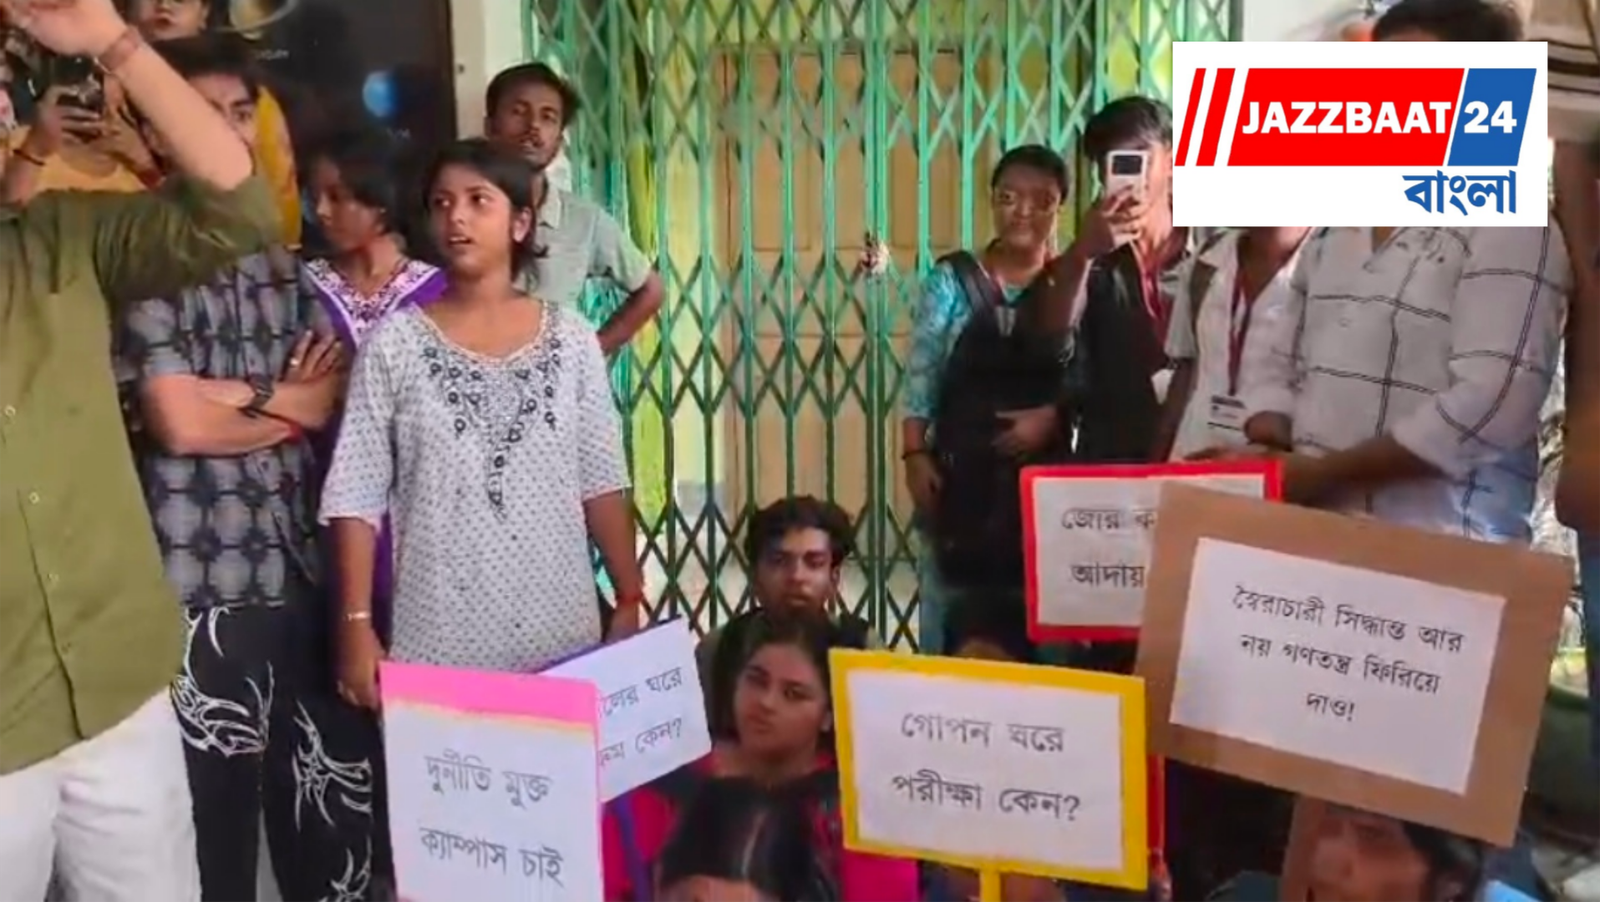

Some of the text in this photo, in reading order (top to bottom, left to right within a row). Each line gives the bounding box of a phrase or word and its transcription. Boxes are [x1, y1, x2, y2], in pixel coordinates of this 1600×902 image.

[1061, 507, 1120, 530] জোর
[1070, 561, 1145, 588] আদায়
[1334, 603, 1407, 640] সিদ্ধান্ত
[1418, 626, 1465, 653] আর
[645, 667, 683, 692] ঘরে
[1240, 634, 1441, 694] নয় গণতন্ত্র ফিরিয়ে
[1306, 691, 1356, 722] দাও!
[634, 717, 683, 754] কেন?
[900, 711, 1064, 752] গোপন ঘরে
[501, 770, 554, 810] মুক্ত
[891, 769, 1081, 822] পরীক্ষা কেন?
[419, 826, 565, 889] ক্যাম্পাস চাই
